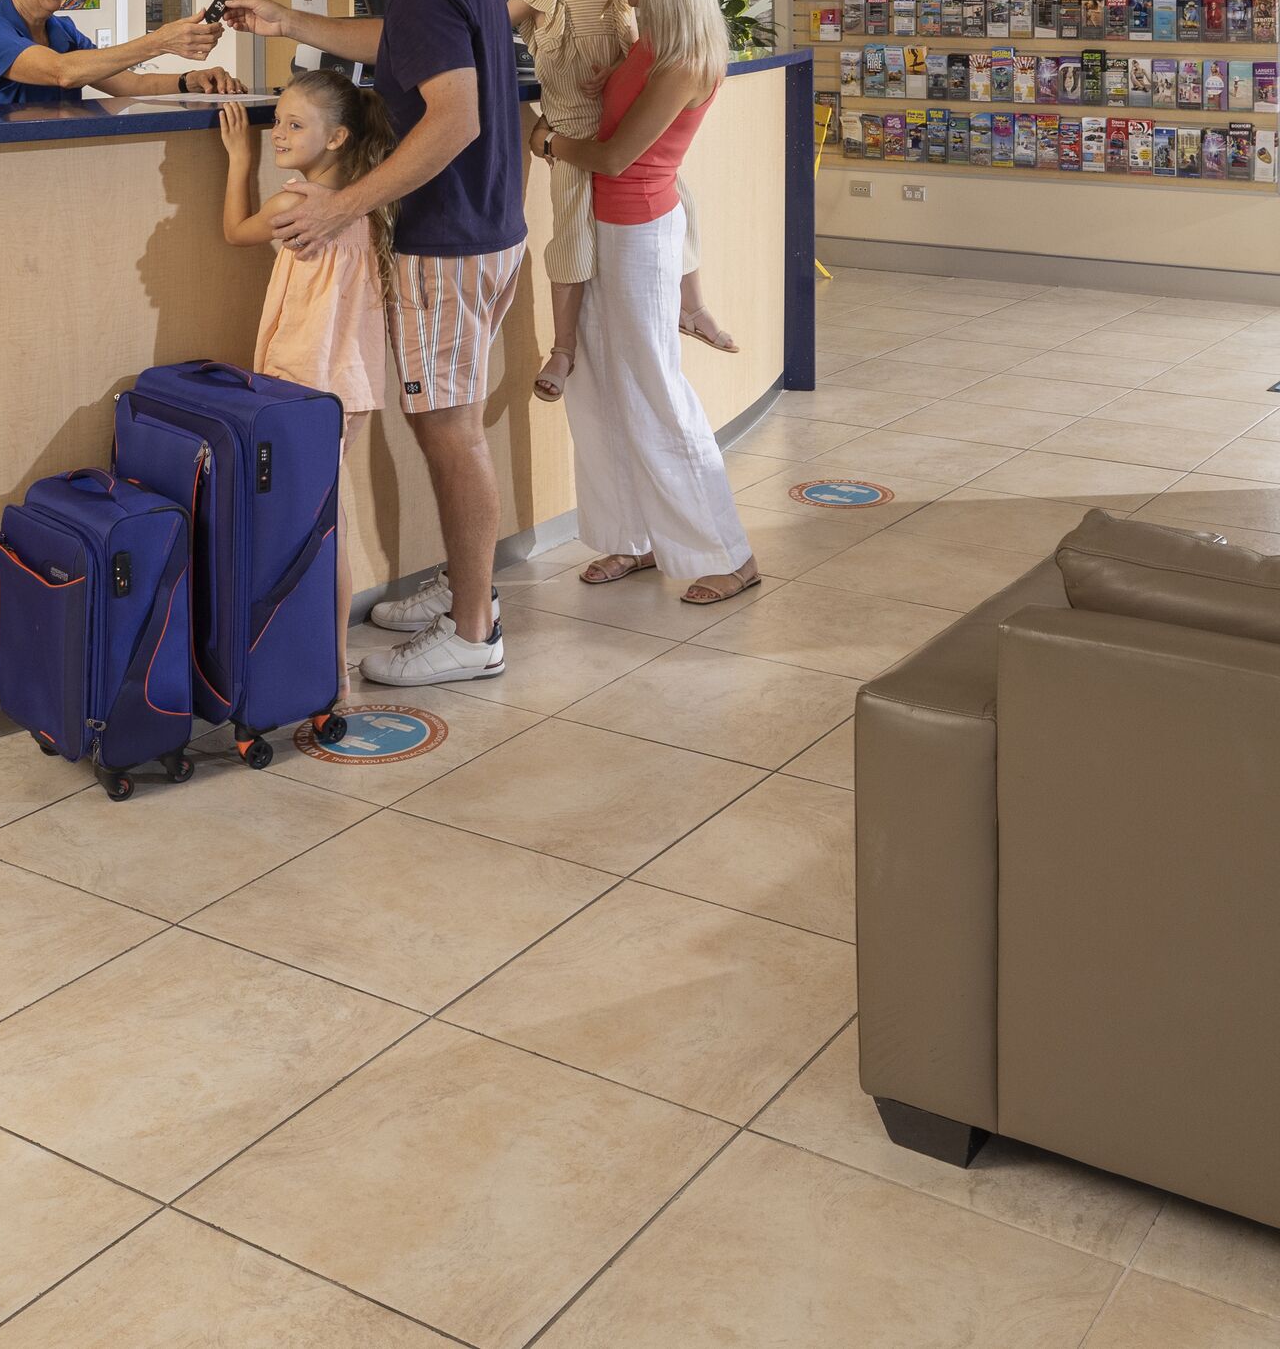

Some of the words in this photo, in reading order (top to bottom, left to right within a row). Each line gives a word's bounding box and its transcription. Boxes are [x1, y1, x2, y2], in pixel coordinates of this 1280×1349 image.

[867, 60, 882, 70] HIRE
[303, 744, 323, 757] SAY
[360, 704, 409, 713] AWAY
[331, 756, 361, 765] THANK
[361, 757, 380, 765] YOU
[381, 756, 400, 764] FOR
